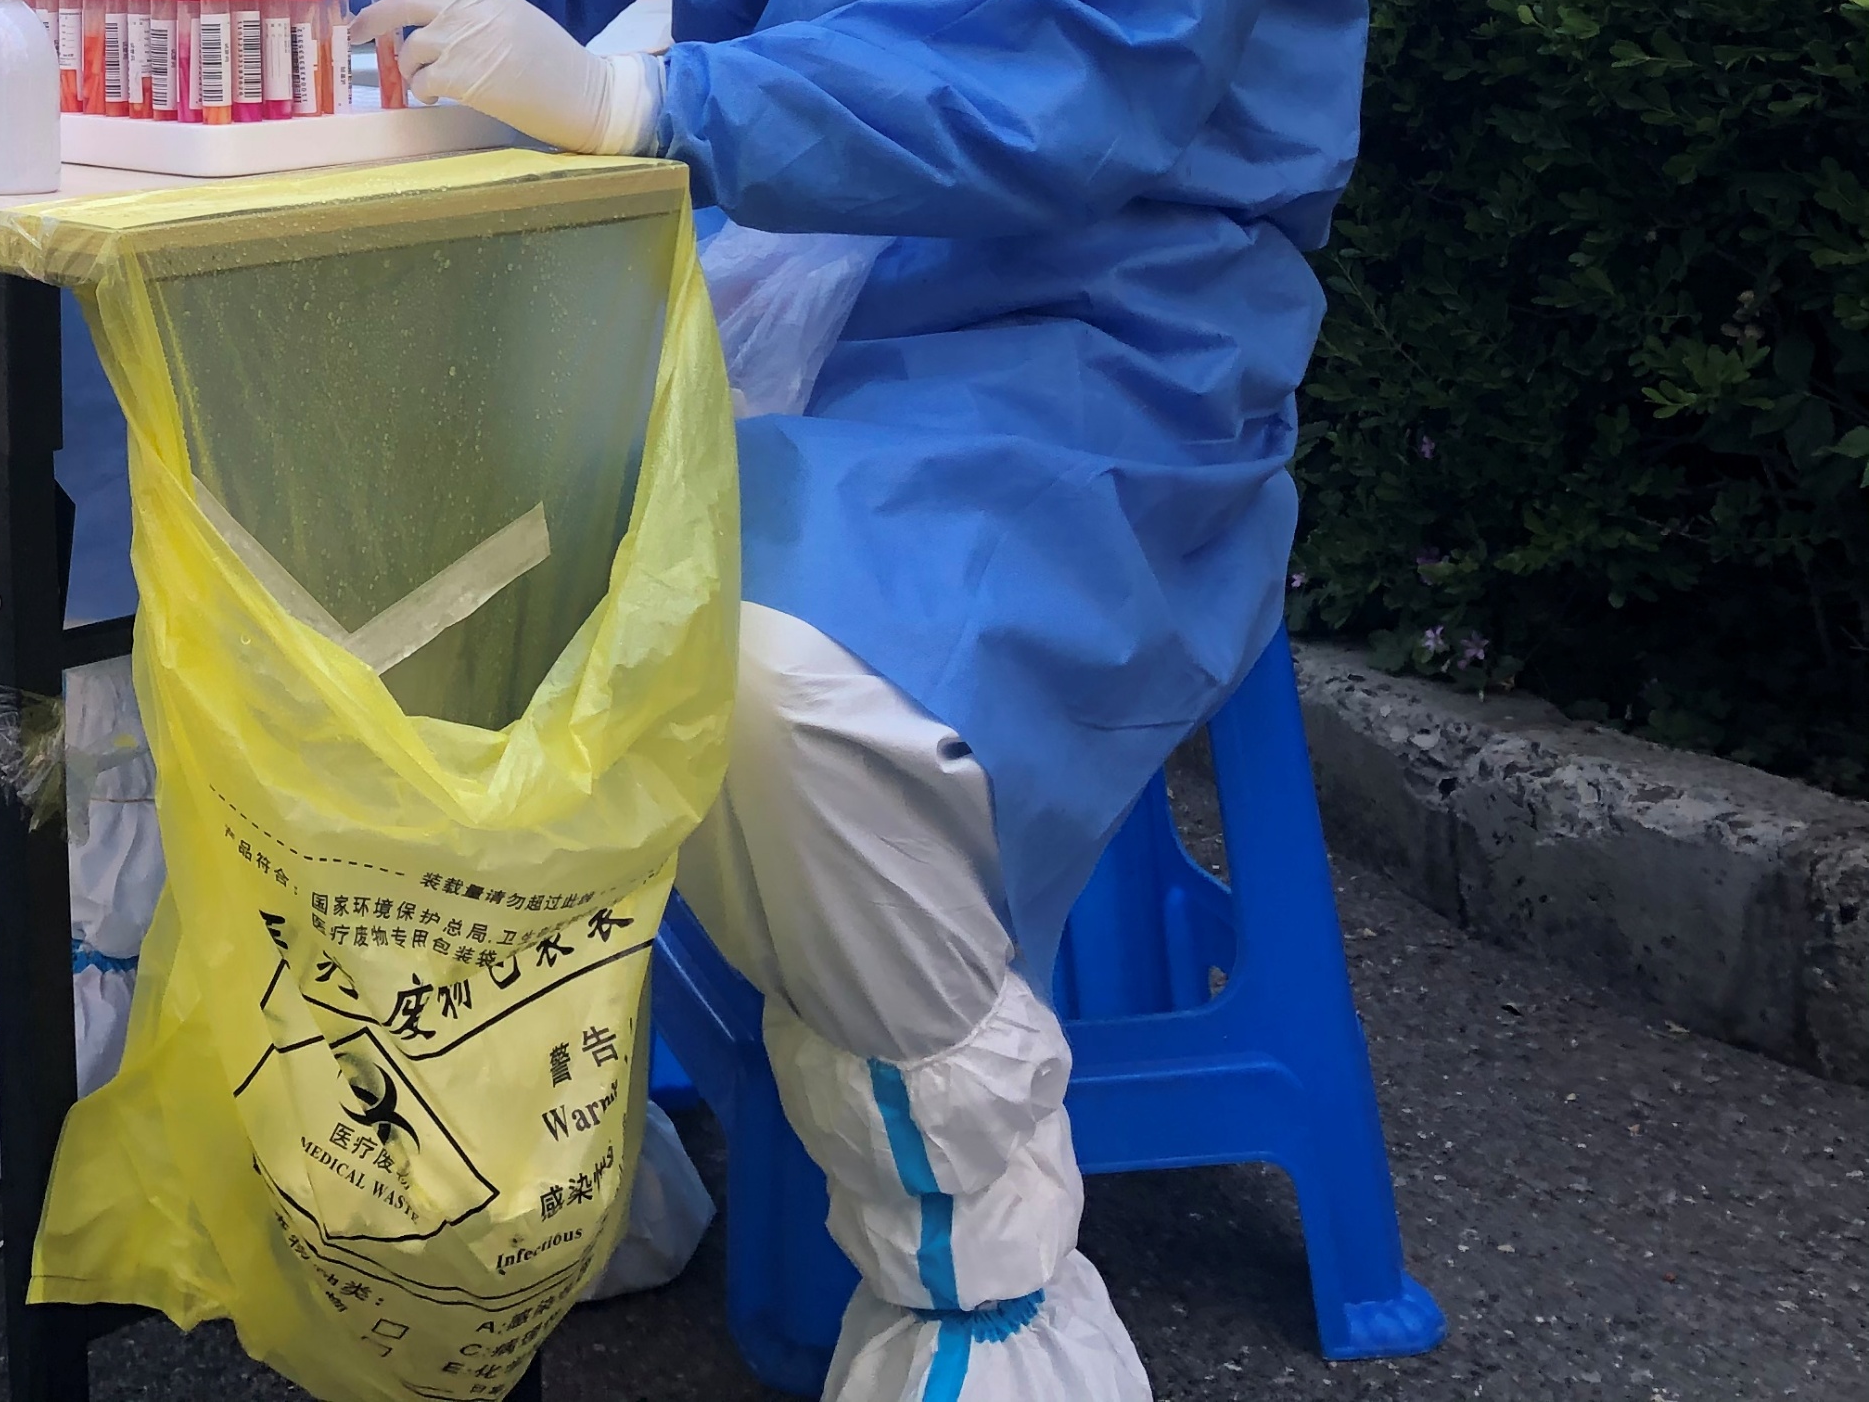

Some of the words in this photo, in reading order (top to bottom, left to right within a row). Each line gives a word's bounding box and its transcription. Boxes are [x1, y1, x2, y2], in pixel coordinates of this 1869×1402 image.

[300, 1135, 366, 1190] MEDICAL
[371, 1180, 420, 1225] WASTE
[496, 1227, 584, 1270] Infectious
